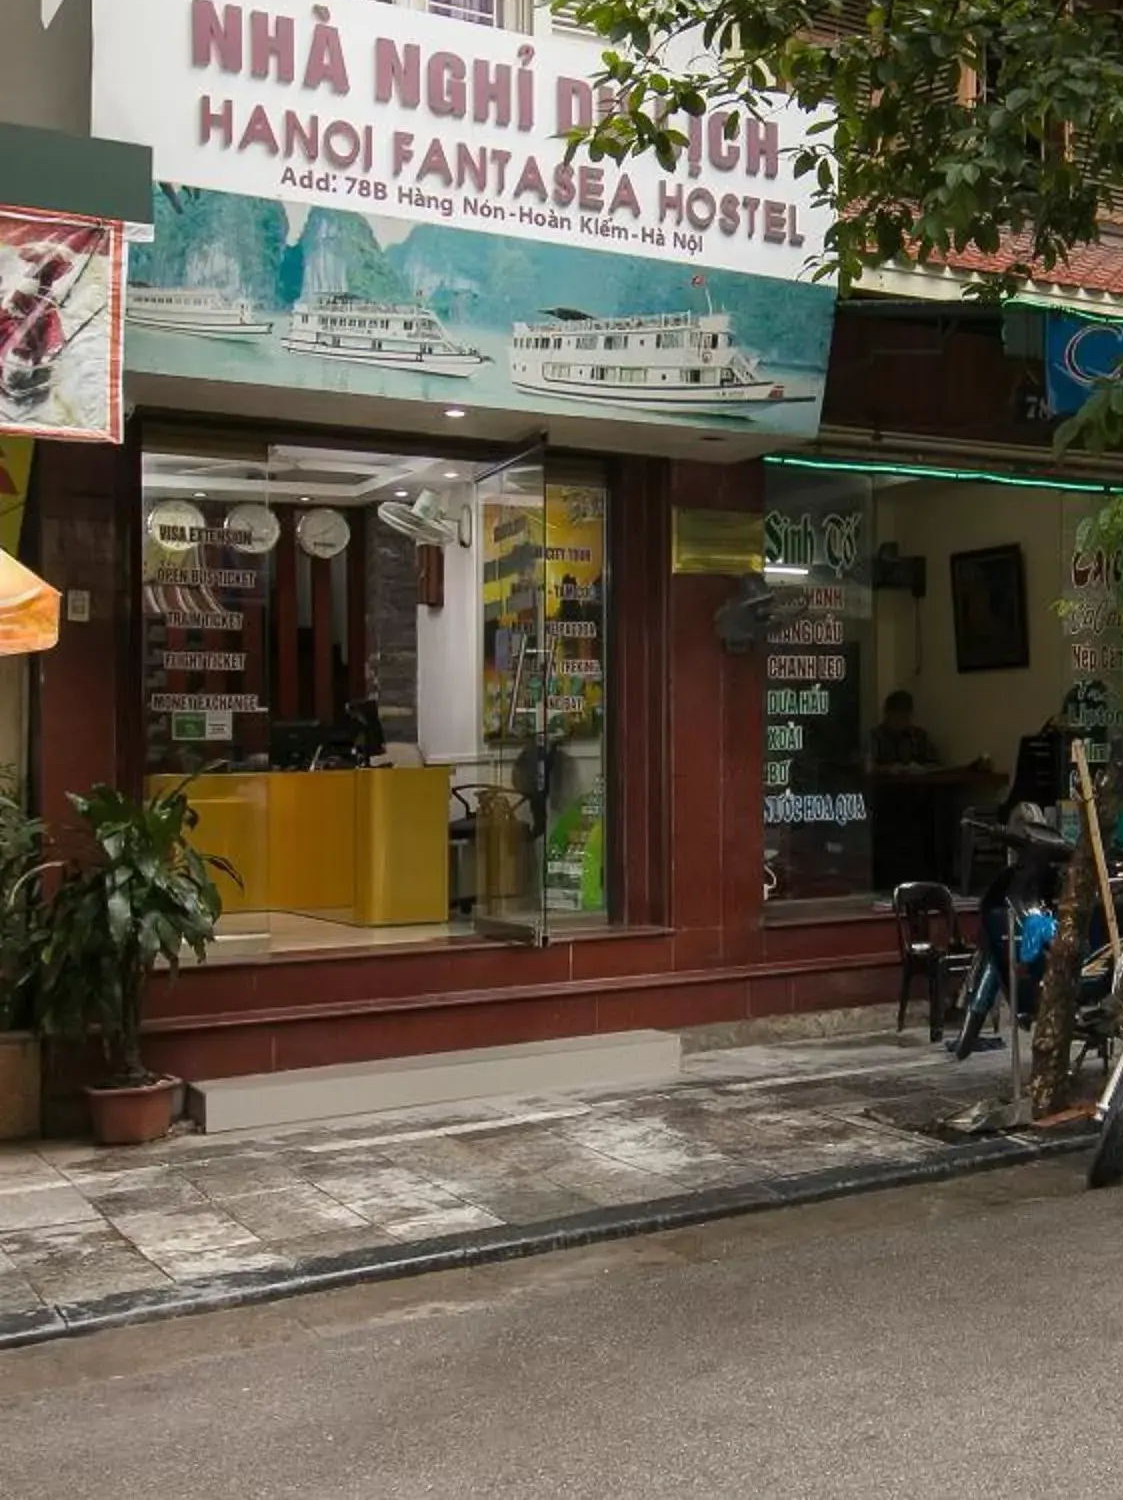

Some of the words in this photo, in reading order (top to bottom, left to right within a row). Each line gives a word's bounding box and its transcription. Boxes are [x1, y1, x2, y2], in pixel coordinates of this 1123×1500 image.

[374, 37, 535, 132] NGHỈ
[200, 94, 373, 175] HANOI
[391, 129, 641, 221] FANTASEA
[658, 179, 807, 250] HOSTEL
[280, 166, 339, 194] Add:
[344, 176, 389, 202] 78B
[397, 185, 454, 218] Hàng
[673, 230, 704, 255] Nội
[159, 524, 186, 542] VISA
[189, 527, 252, 545] EXTENSION
[765, 510, 815, 567] Sinh
[157, 567, 188, 585] OPEN
[190, 568, 215, 587] BUS
[217, 569, 257, 588] TICKET
[168, 611, 203, 629] TRAIN
[204, 612, 243, 631] TICKET
[202, 652, 246, 671] TICKET
[767, 655, 817, 680] CHANH
[818, 655, 846, 681] LEO
[767, 720, 803, 751] XOÀI
[803, 794, 835, 821] HOA
